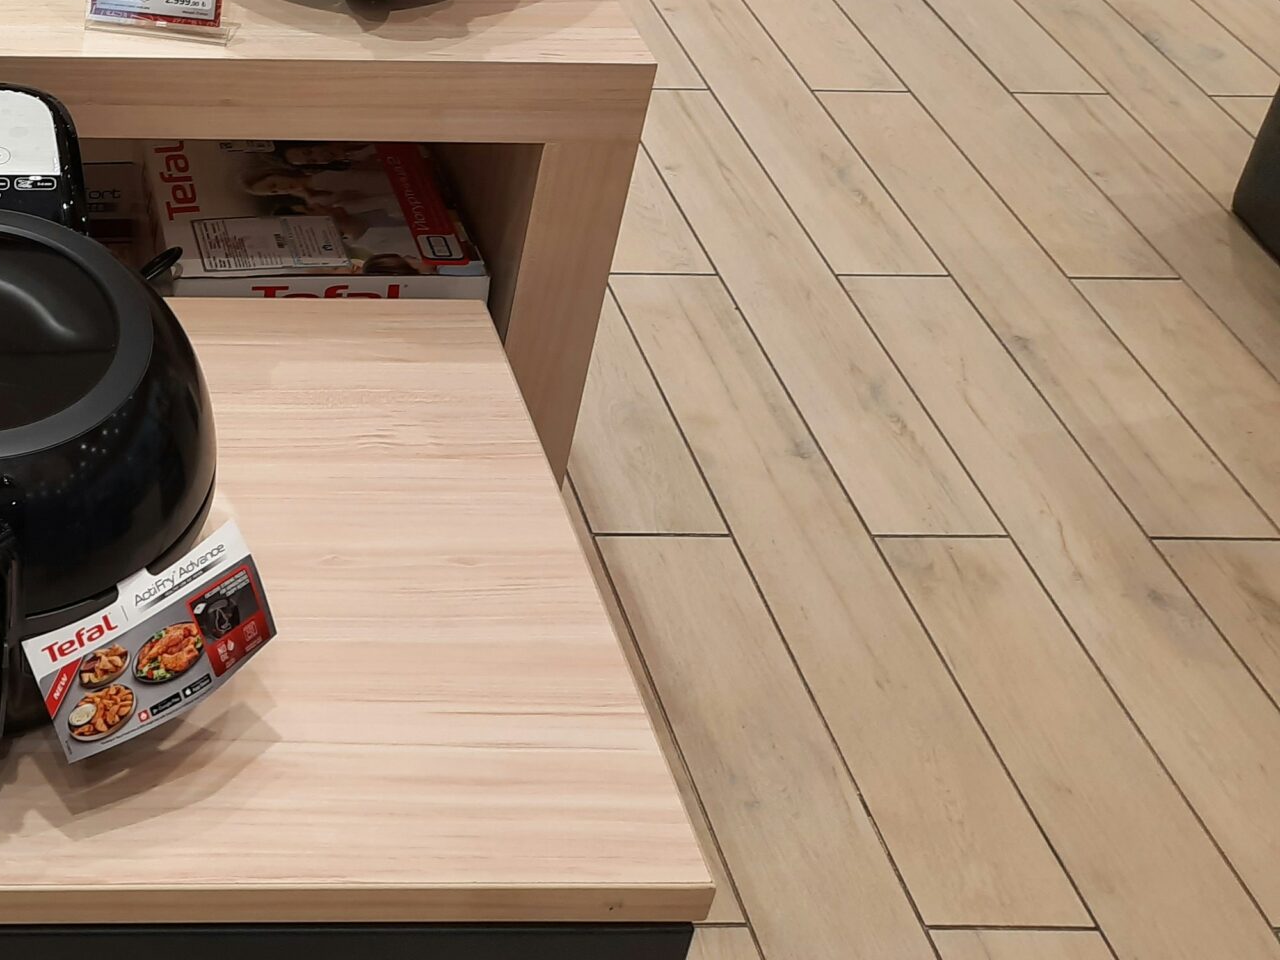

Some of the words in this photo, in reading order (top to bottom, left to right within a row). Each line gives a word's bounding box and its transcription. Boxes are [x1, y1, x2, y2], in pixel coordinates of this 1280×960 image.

[154, 140, 200, 221] Tefal
[178, 543, 226, 579] Advance
[41, 613, 118, 663] Tefal
[53, 674, 68, 700] NEW
